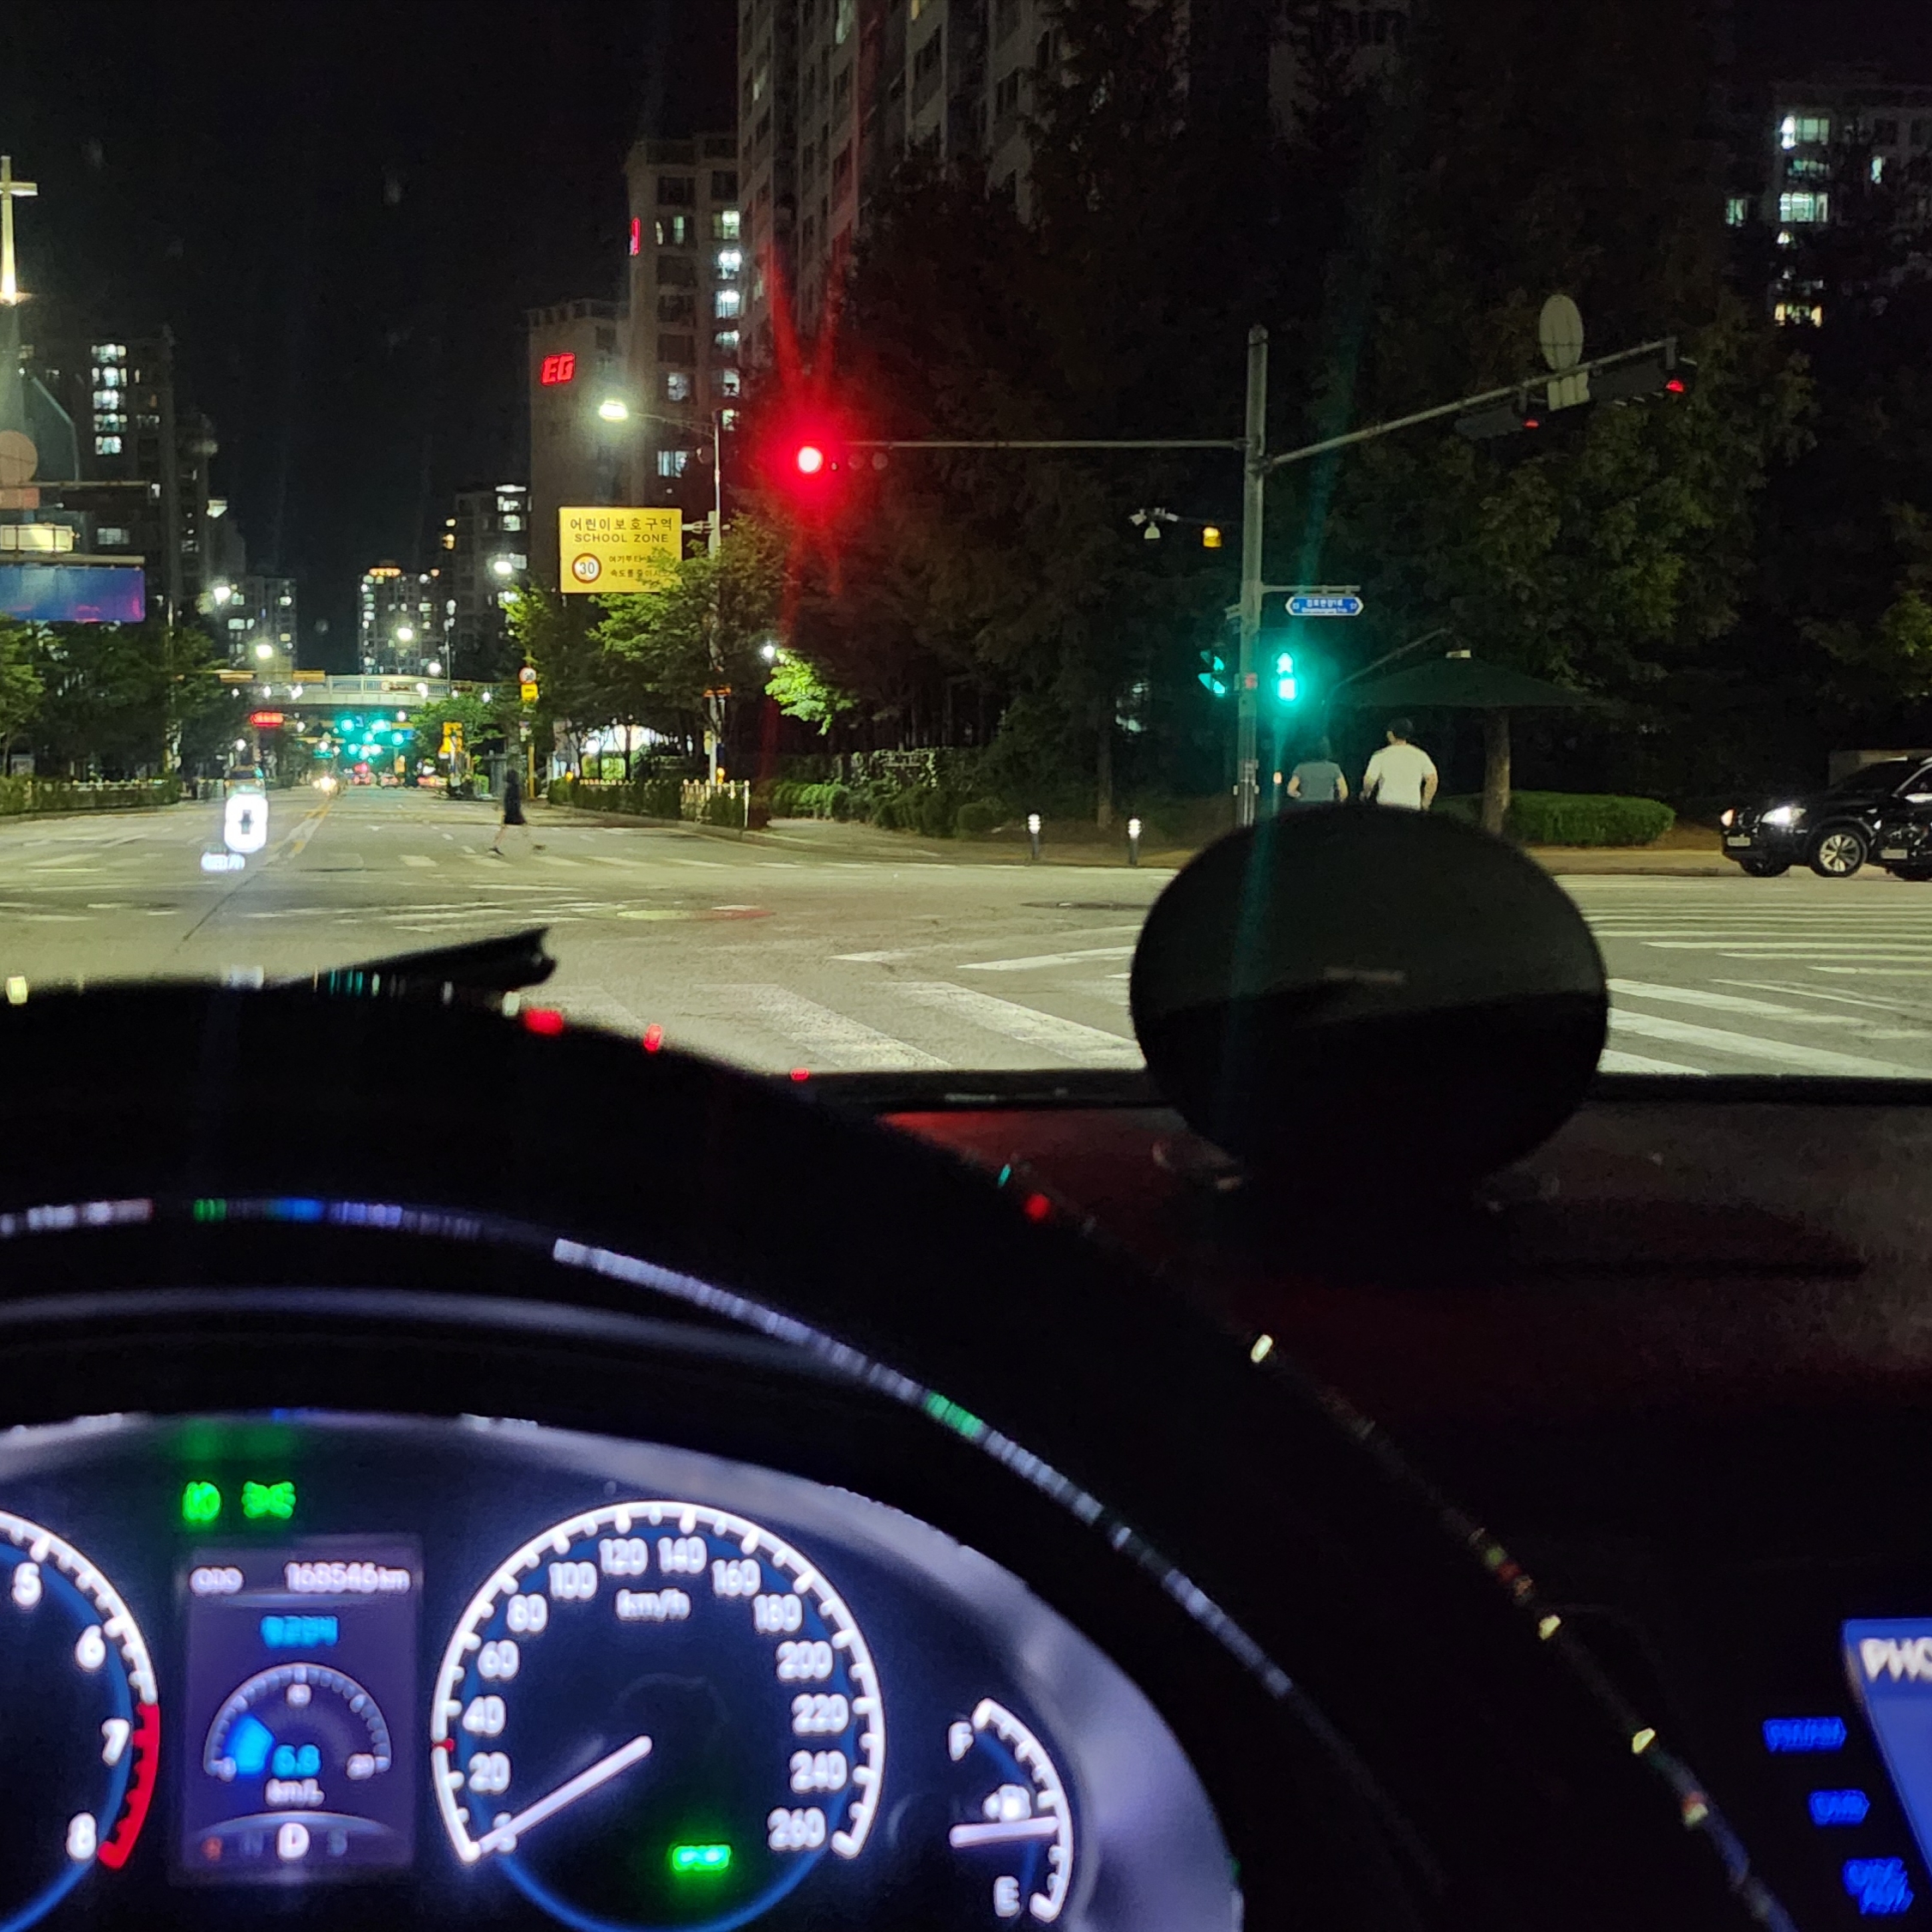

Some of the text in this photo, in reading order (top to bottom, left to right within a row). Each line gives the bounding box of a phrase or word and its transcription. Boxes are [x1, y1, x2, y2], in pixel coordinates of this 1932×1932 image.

[541, 353, 576, 385] EG
[570, 517, 673, 531] 어린이보호구역
[574, 534, 669, 543] SCHOOL ZONE
[579, 562, 595, 575] 30
[599, 1537, 648, 1575] 120
[657, 1537, 707, 1573] 140
[12, 1562, 41, 1607] 5
[549, 1561, 597, 1599] 100
[712, 1559, 761, 1596] 160
[507, 1594, 548, 1632] 80
[616, 1589, 690, 1621] km/h
[753, 1594, 803, 1632] 180
[75, 1625, 106, 1669] 6
[477, 1640, 519, 1679] 60
[777, 1640, 833, 1680] 200
[462, 1695, 506, 1736] 40
[792, 1694, 848, 1734] 220
[101, 1718, 130, 1766] 7
[948, 1721, 974, 1760] F
[468, 1752, 510, 1793] 20
[790, 1750, 848, 1792] 240
[66, 1813, 96, 1860] 8
[277, 1822, 310, 1860] D
[769, 1808, 825, 1850] 260
[993, 1875, 1020, 1917] E
